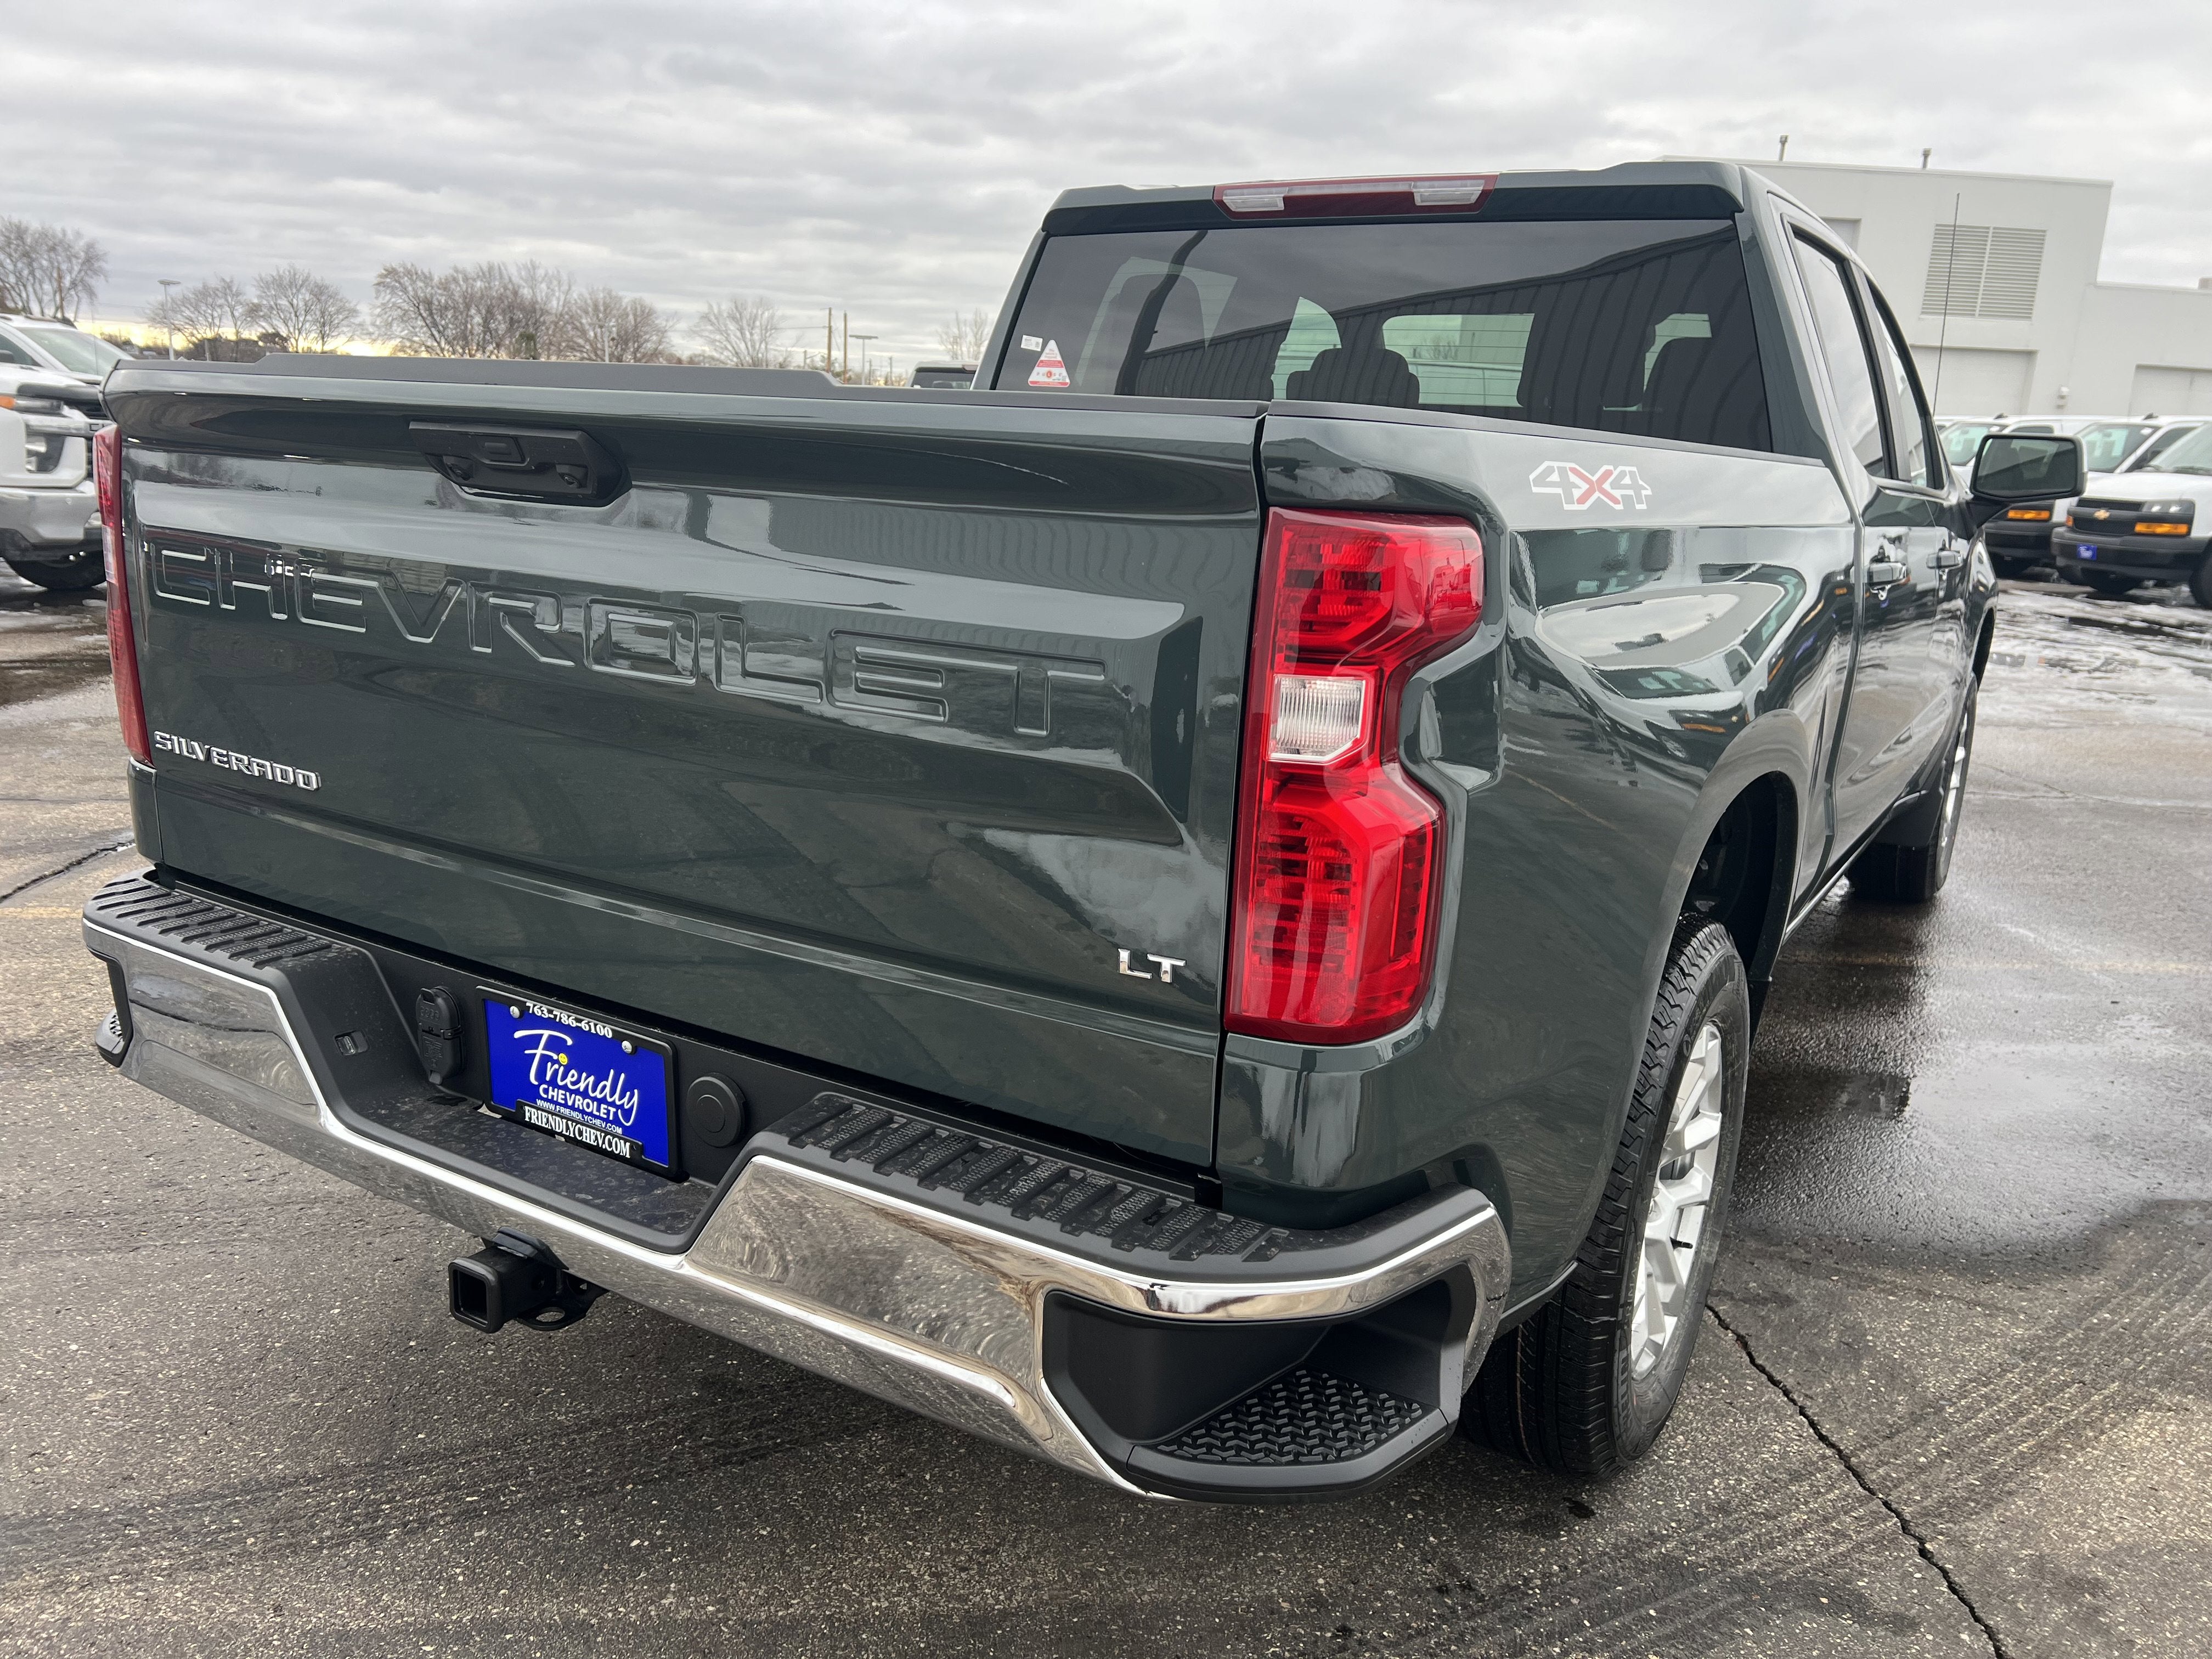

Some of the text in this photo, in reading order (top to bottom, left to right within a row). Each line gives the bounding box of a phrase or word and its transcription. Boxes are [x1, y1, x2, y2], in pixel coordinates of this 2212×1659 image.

[1529, 461, 1652, 510] 4X4
[150, 542, 1107, 736] CHEVROLET
[154, 731, 322, 791] SILVERADO
[1118, 948, 1187, 983] LT
[526, 1002, 613, 1039] 763-786-6100
[514, 1029, 639, 1126] Friendly
[536, 1098, 623, 1135] WWW.FRIENDLYCHEV.COM
[539, 1084, 617, 1121] CHEVROLET
[523, 1105, 631, 1158] FRIENDLYCHEV.COM
